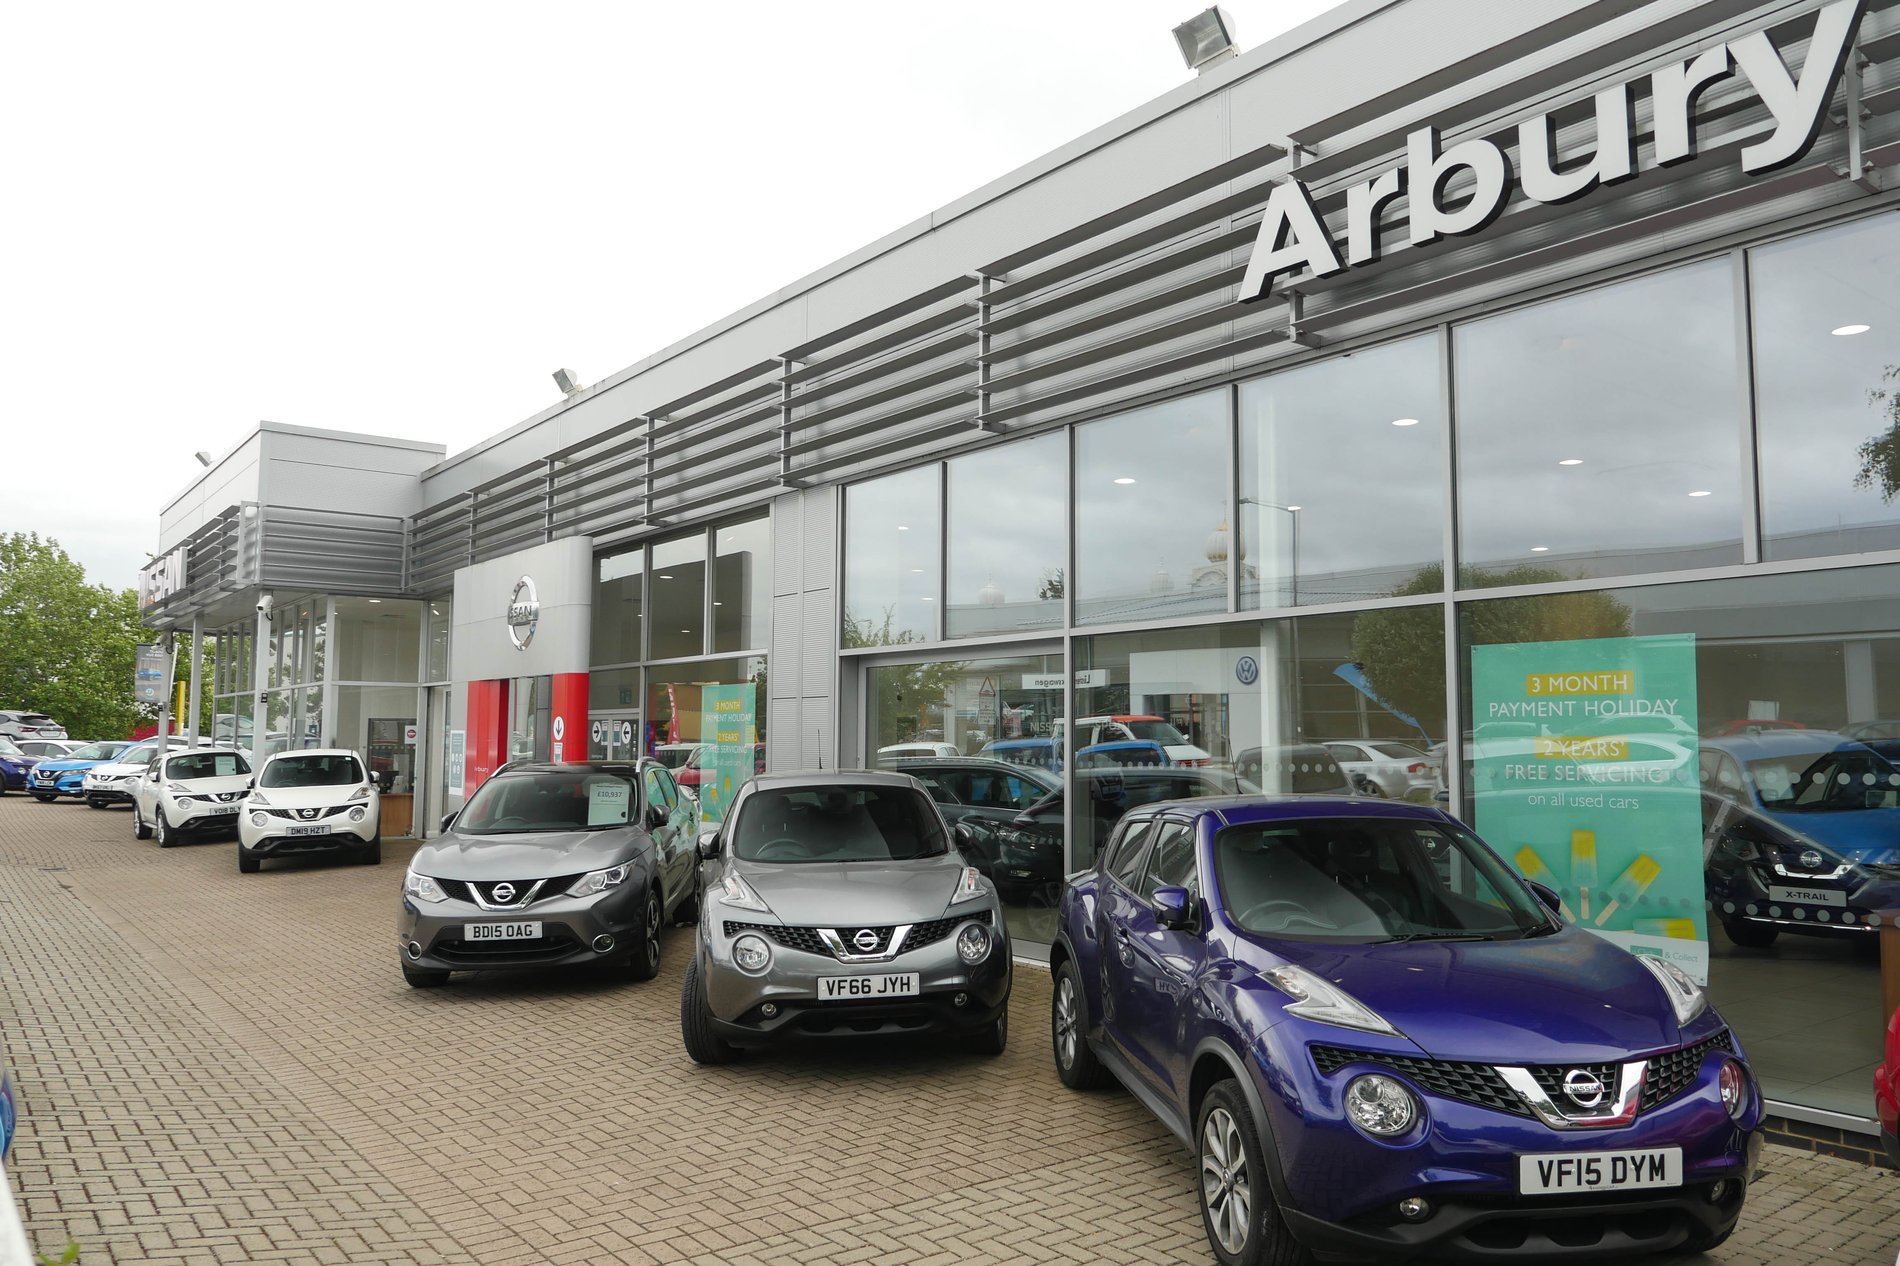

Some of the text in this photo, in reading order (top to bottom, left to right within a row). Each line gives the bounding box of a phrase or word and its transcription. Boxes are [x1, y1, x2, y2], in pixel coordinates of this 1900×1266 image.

[1237, 0, 1866, 302] Arbury
[1532, 674, 1628, 693] 3 MONTH
[720, 701, 741, 710] MONTH
[1489, 699, 1679, 717] PAYMENT HOLIDAY
[728, 713, 752, 721] HOLIDAY
[1544, 741, 1553, 756] 2
[1505, 764, 1665, 783] FREE SERVICING
[1528, 792, 1639, 809] on all used cars
[291, 826, 325, 835] DM19 HZT
[1785, 890, 1829, 901] X-TRAIL
[473, 924, 533, 938] BD15 OAG
[1673, 952, 1698, 962] Collect
[826, 976, 910, 996] VF66 JYH
[1569, 1084, 1601, 1093] NISSAN
[1537, 1153, 1665, 1188] VF15 DYM
